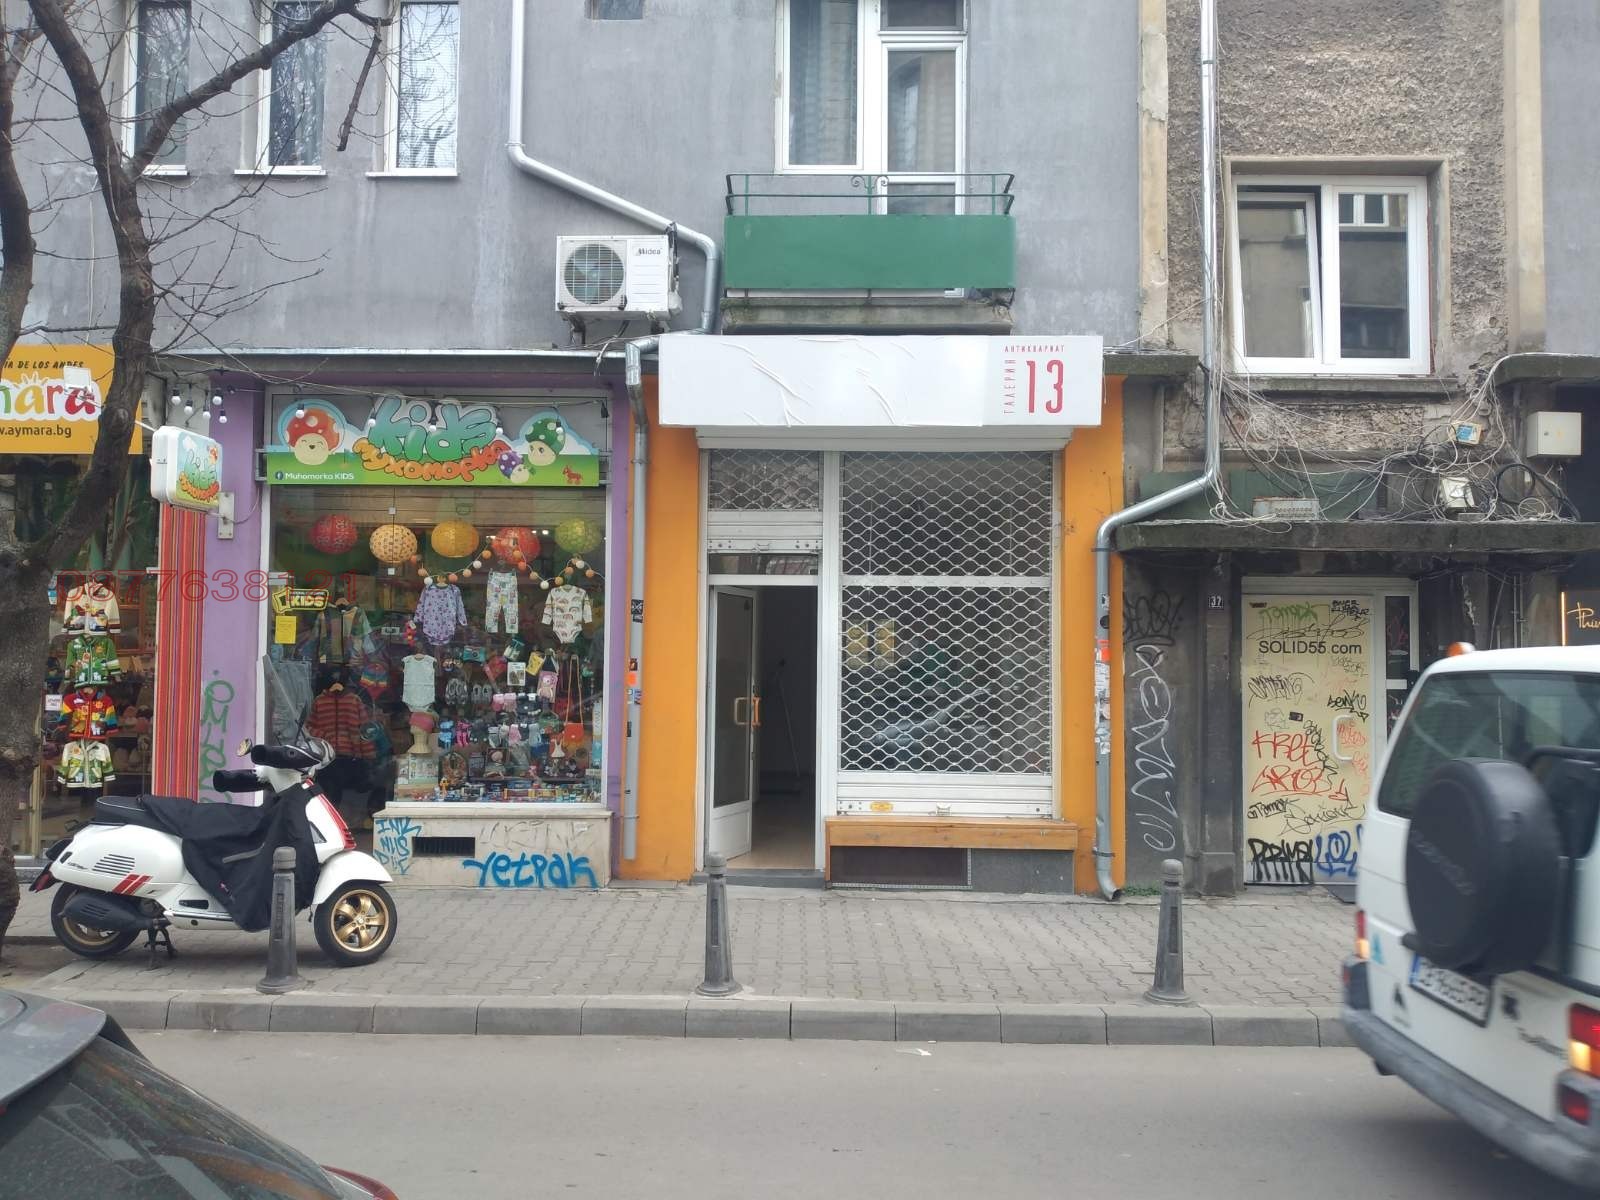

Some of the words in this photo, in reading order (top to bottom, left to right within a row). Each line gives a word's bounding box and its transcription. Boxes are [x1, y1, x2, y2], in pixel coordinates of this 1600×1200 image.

[638, 247, 661, 255] Midea
[1004, 344, 1065, 353] АНТИКВАРИАТ
[17, 361, 30, 369] DE
[32, 360, 50, 369] LOS
[1026, 359, 1064, 414] 13
[285, 472, 333, 480] Muhomorka
[334, 472, 354, 480] KIDS
[290, 595, 325, 608] KIDS
[1258, 640, 1362, 654] SOLID55.com
